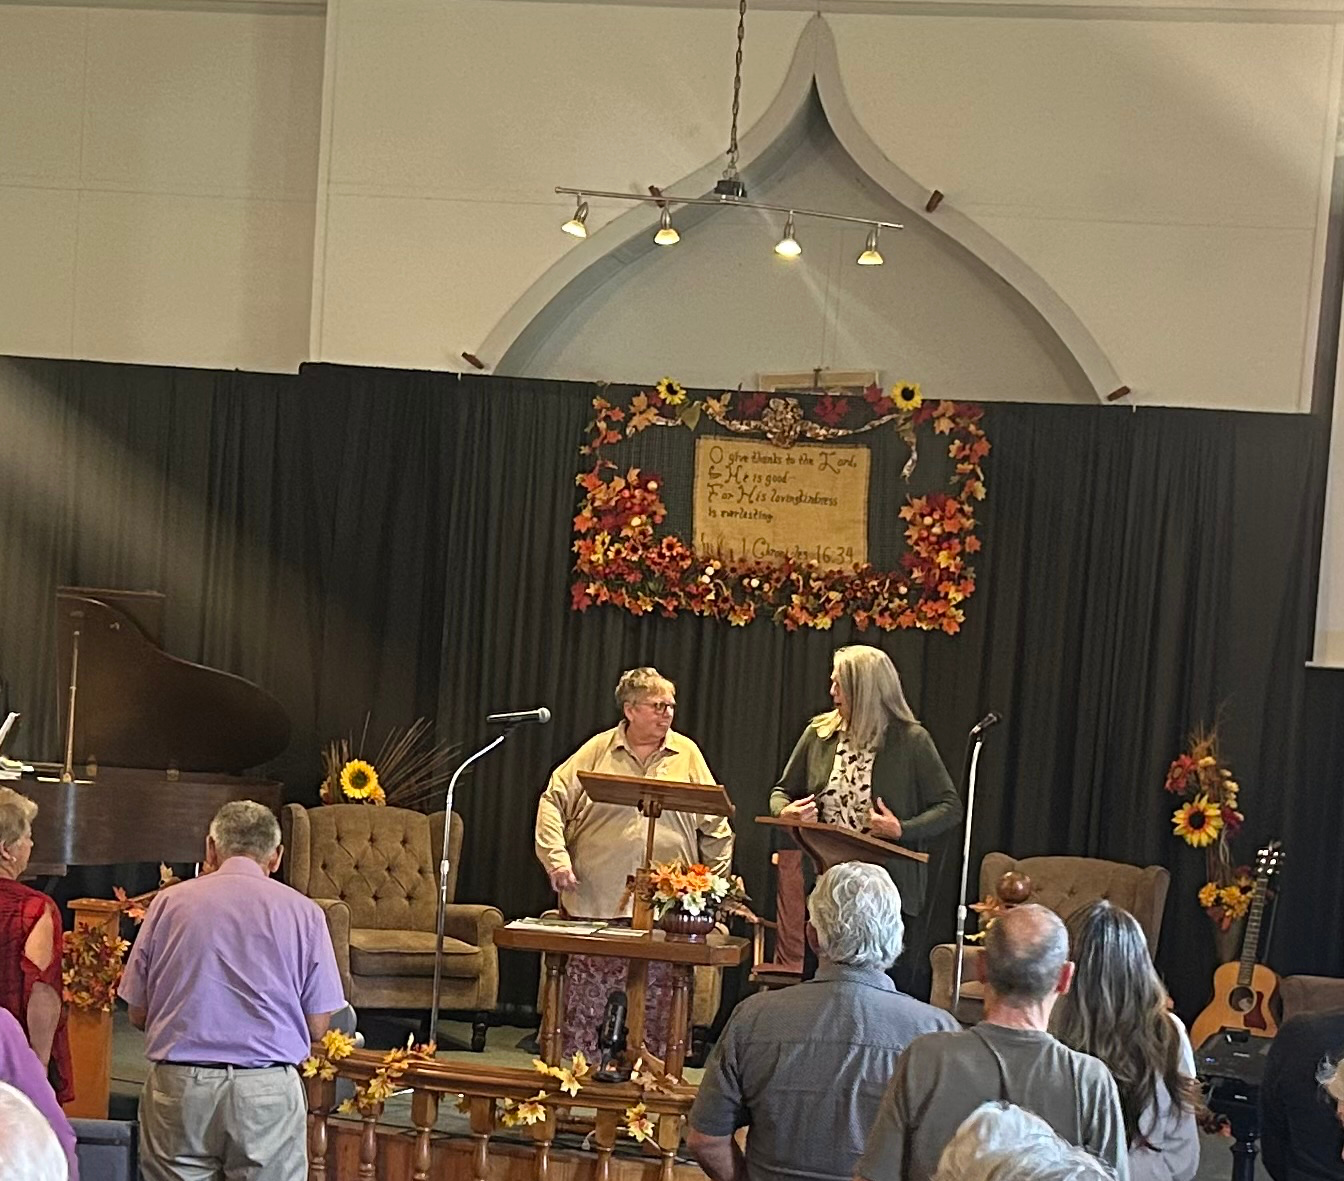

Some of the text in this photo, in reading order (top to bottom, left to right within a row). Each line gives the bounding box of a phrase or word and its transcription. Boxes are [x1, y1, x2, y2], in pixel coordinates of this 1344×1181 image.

[709, 445, 724, 464] O
[785, 453, 796, 464] to
[798, 453, 814, 465] the
